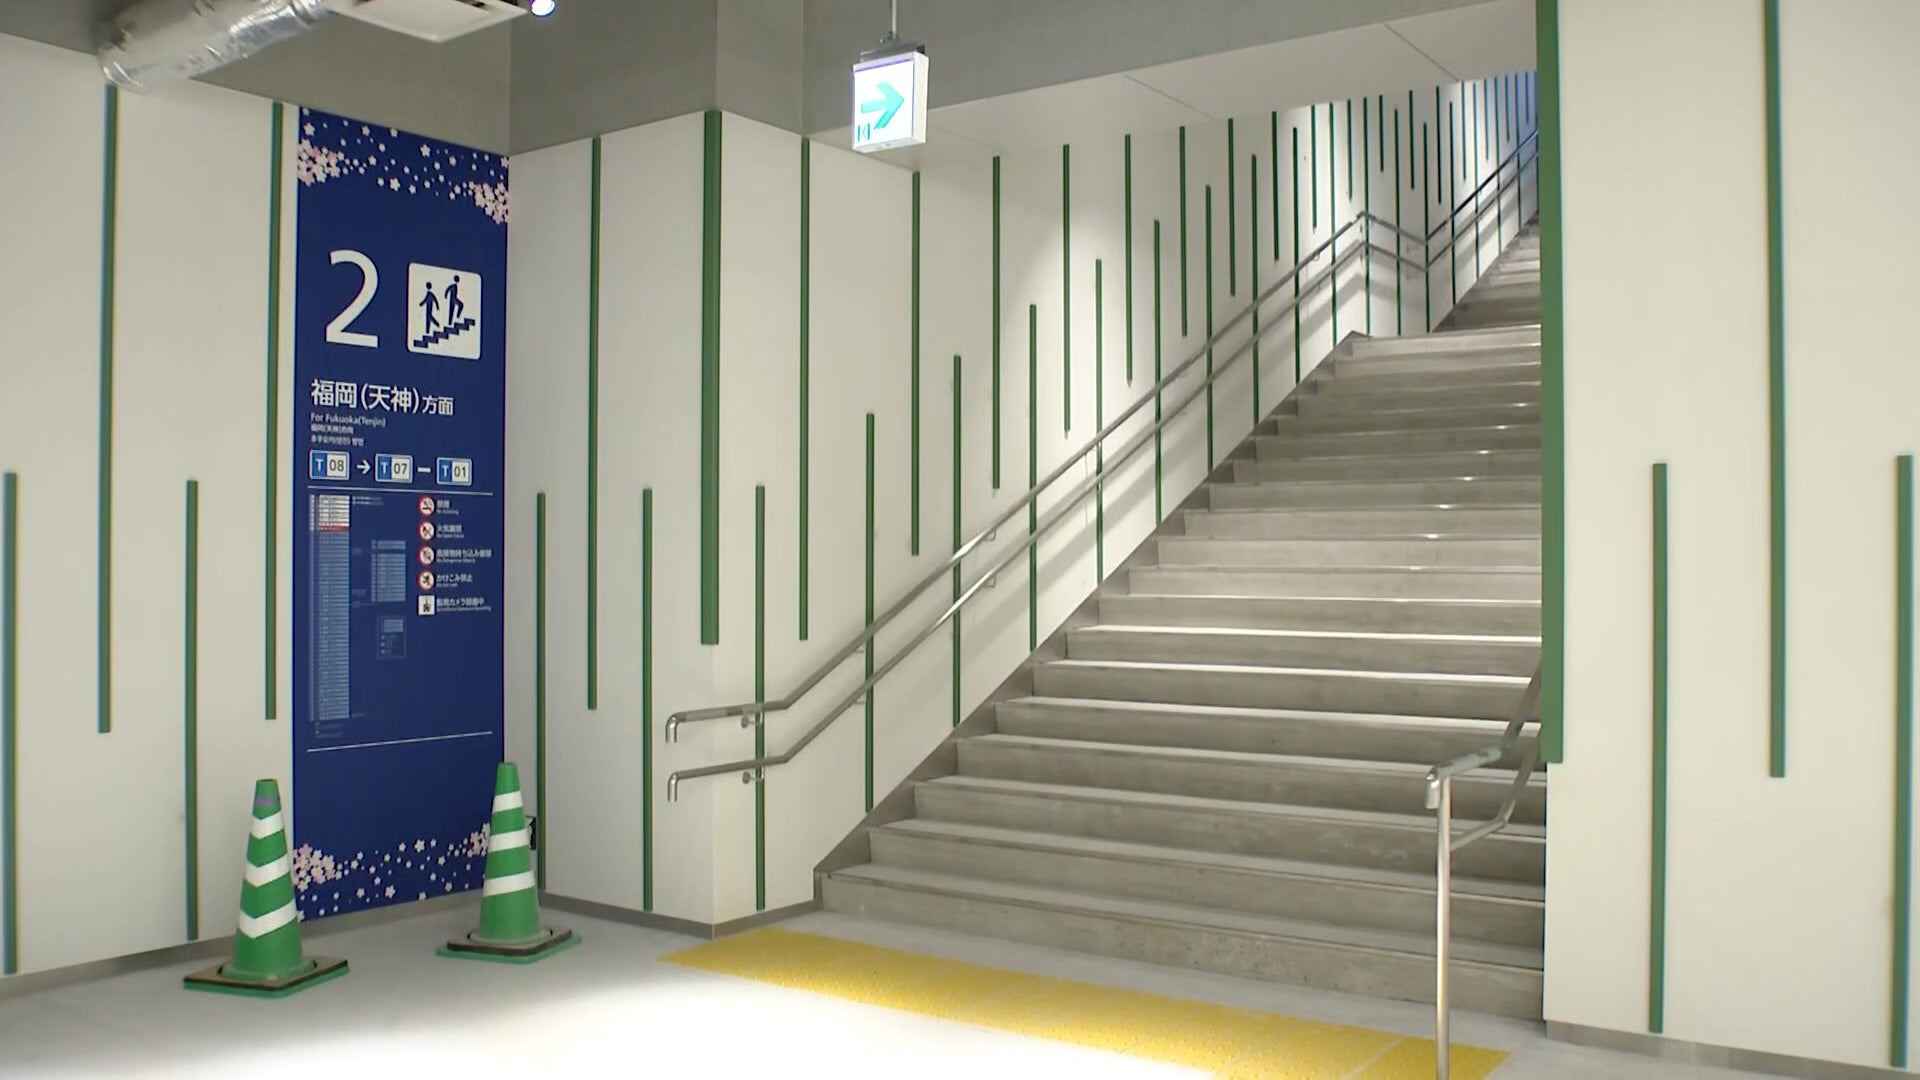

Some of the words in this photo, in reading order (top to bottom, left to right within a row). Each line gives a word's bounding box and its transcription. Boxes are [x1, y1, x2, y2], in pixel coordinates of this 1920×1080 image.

[325, 249, 379, 348] 2
[311, 412, 324, 422] For
[325, 413, 386, 428] Fukuoka(Tenjin)
[329, 459, 345, 472] 08
[393, 462, 408, 475] 07
[454, 464, 467, 478] 01
